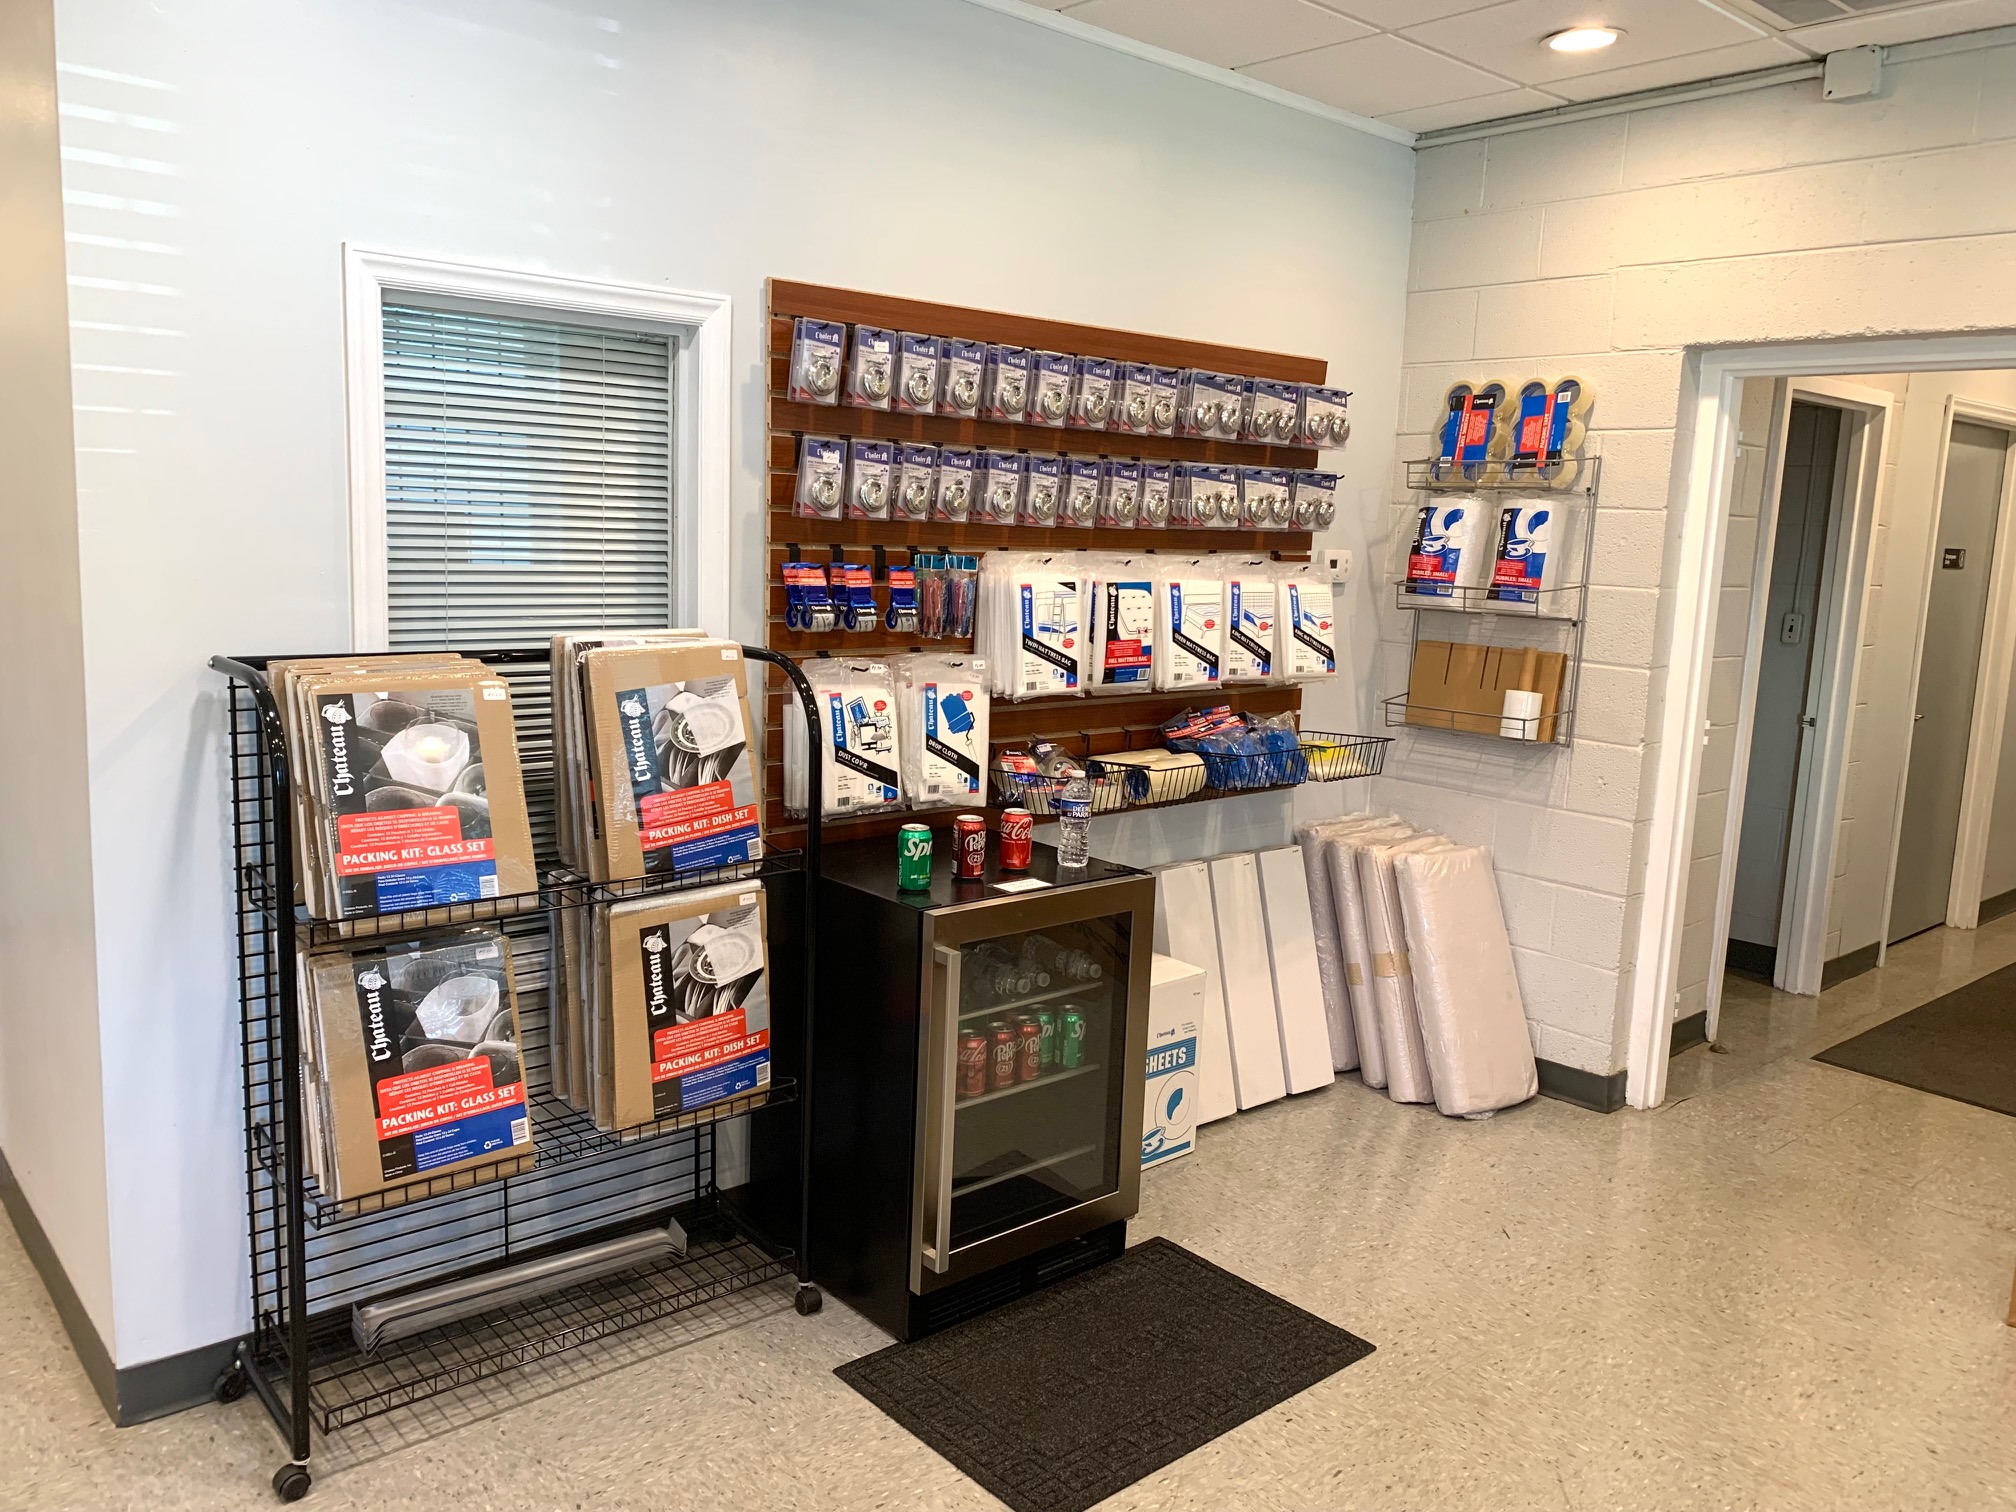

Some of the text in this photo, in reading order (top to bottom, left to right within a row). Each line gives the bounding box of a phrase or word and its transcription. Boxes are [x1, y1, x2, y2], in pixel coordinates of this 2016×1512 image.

[1025, 638, 1072, 666] TWIN MATTRESS BAG
[1186, 639, 1207, 657] MATTRESS
[1206, 653, 1216, 662] BAG
[1258, 648, 1266, 656] BAG
[1321, 645, 1330, 654] BAG
[835, 710, 844, 742] Chateau
[330, 725, 355, 797] Chateau
[629, 717, 652, 782] Chateau
[838, 750, 852, 761] DUST
[928, 739, 958, 760] DROP CLOTH
[649, 823, 691, 840] PACKING
[693, 818, 710, 830] KIT:
[712, 813, 733, 826] DISH
[734, 809, 749, 819] SET
[342, 850, 398, 865] PACKING
[401, 848, 423, 859] KIT:
[427, 844, 463, 856] GLASS
[466, 842, 485, 851] SET
[904, 837, 932, 861] Spr
[965, 835, 986, 852] Pepp
[650, 952, 668, 1016] Chateau
[366, 990, 392, 1062] Chateau
[660, 1034, 761, 1072] PACKING KIT: DISH SET
[993, 1044, 1016, 1062] Pepp
[1146, 1046, 1187, 1073] HEETS
[382, 1108, 434, 1129] PACKING
[437, 1101, 458, 1114] KIT:
[461, 1091, 495, 1109] GLASS
[498, 1086, 516, 1098] SET
